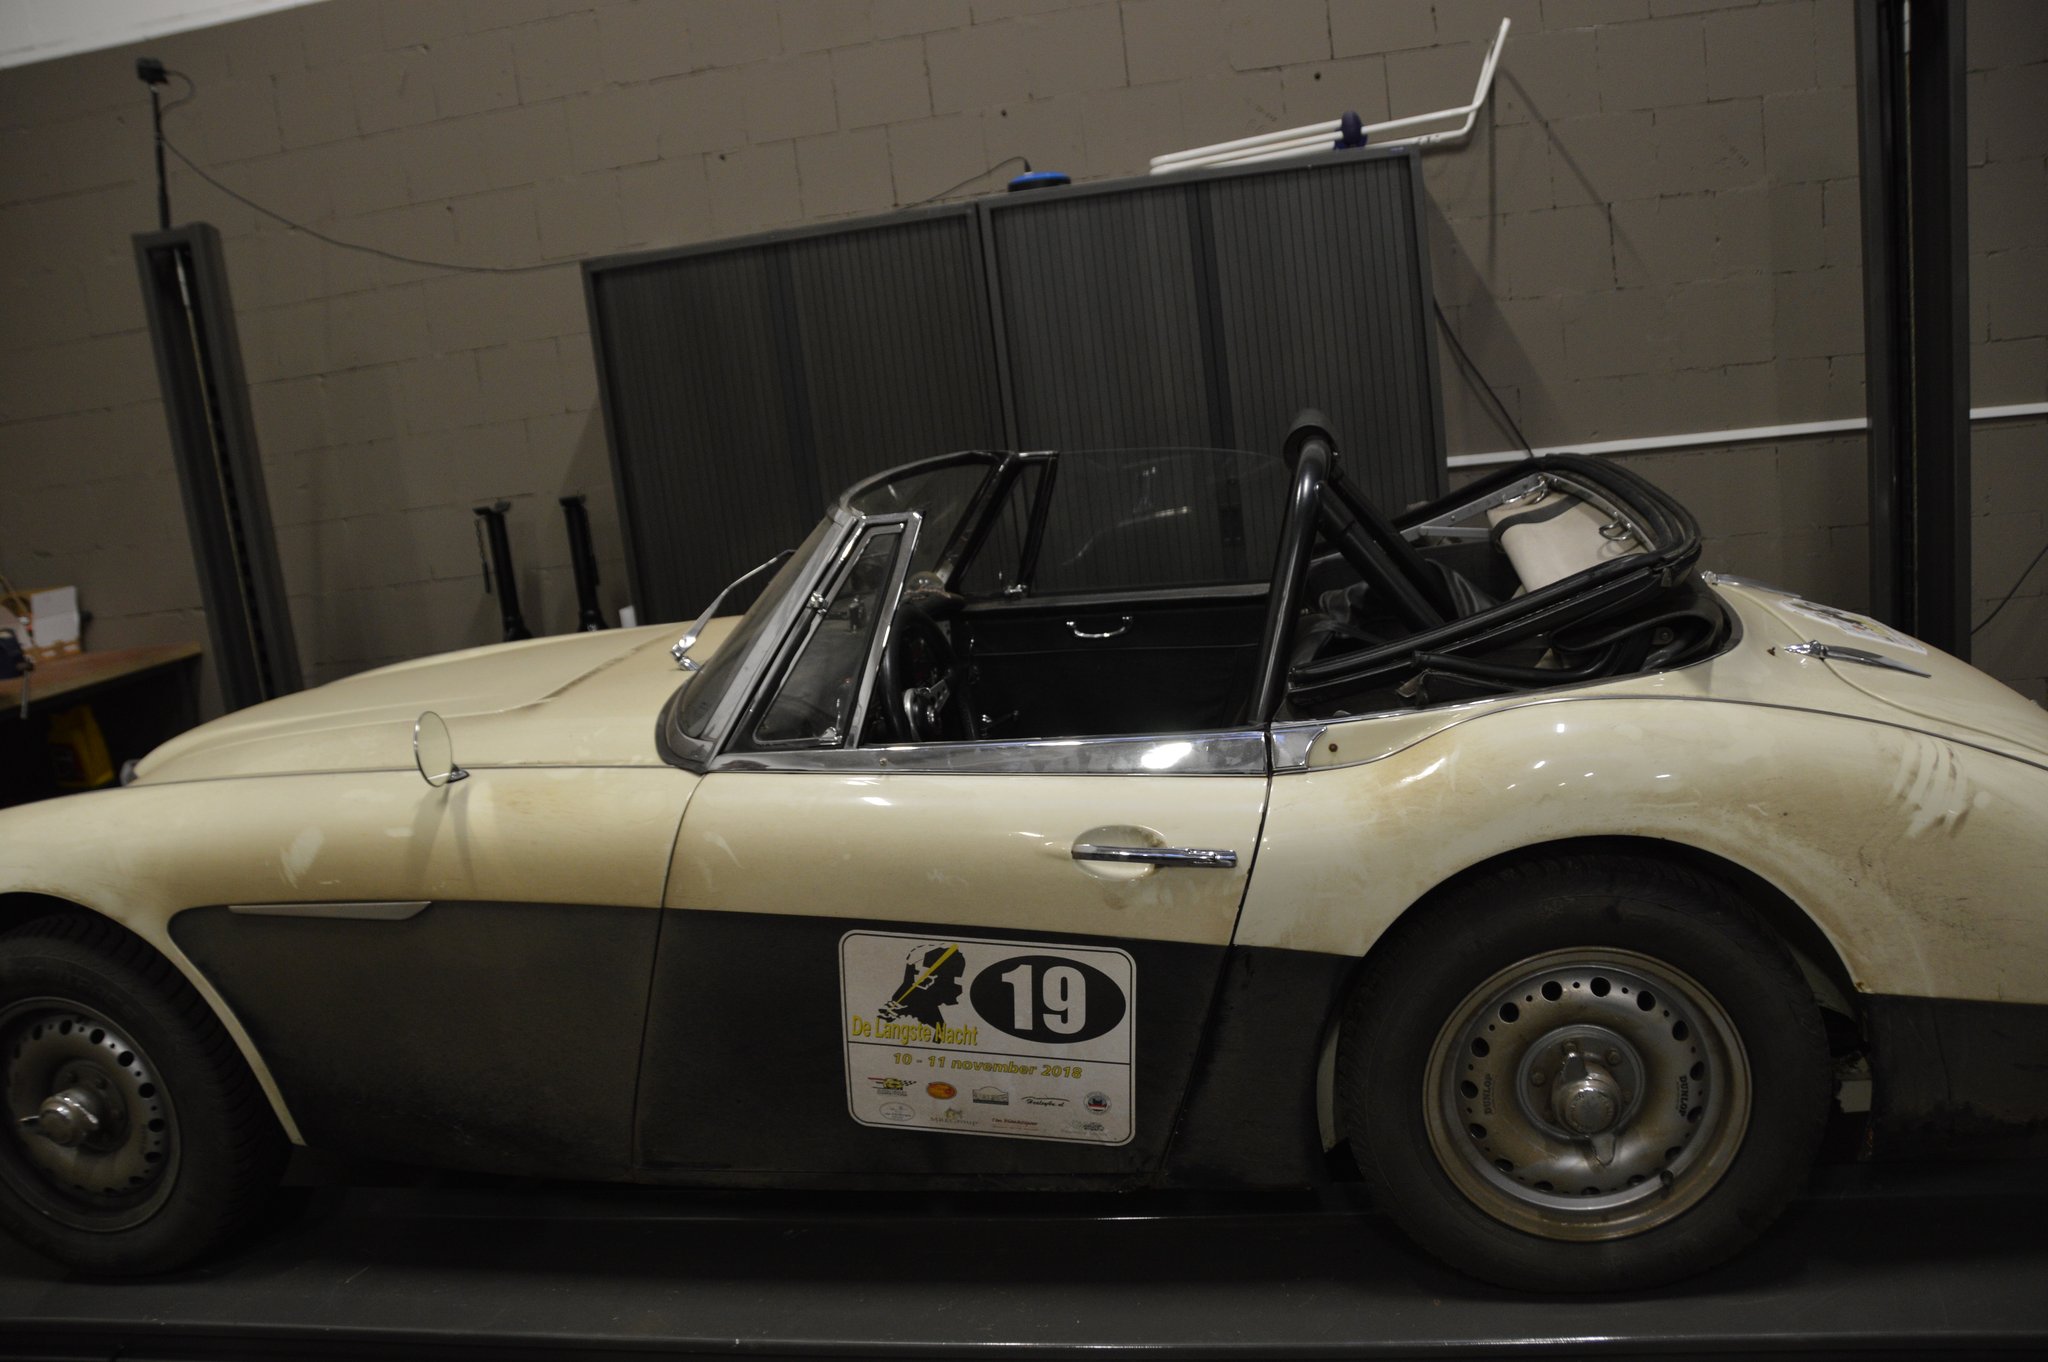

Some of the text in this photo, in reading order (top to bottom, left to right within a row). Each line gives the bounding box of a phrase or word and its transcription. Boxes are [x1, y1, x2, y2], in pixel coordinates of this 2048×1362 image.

[1001, 964, 1086, 1035] 19
[852, 1015, 978, 1046] De Langste Nacht
[893, 1052, 913, 1066] 10
[928, 1055, 946, 1069] 11
[950, 1058, 1037, 1075] november
[1040, 1064, 1083, 1079] 2018
[1482, 1073, 1493, 1115] DUNLOP
[1678, 1075, 1689, 1117] DUNLOP
